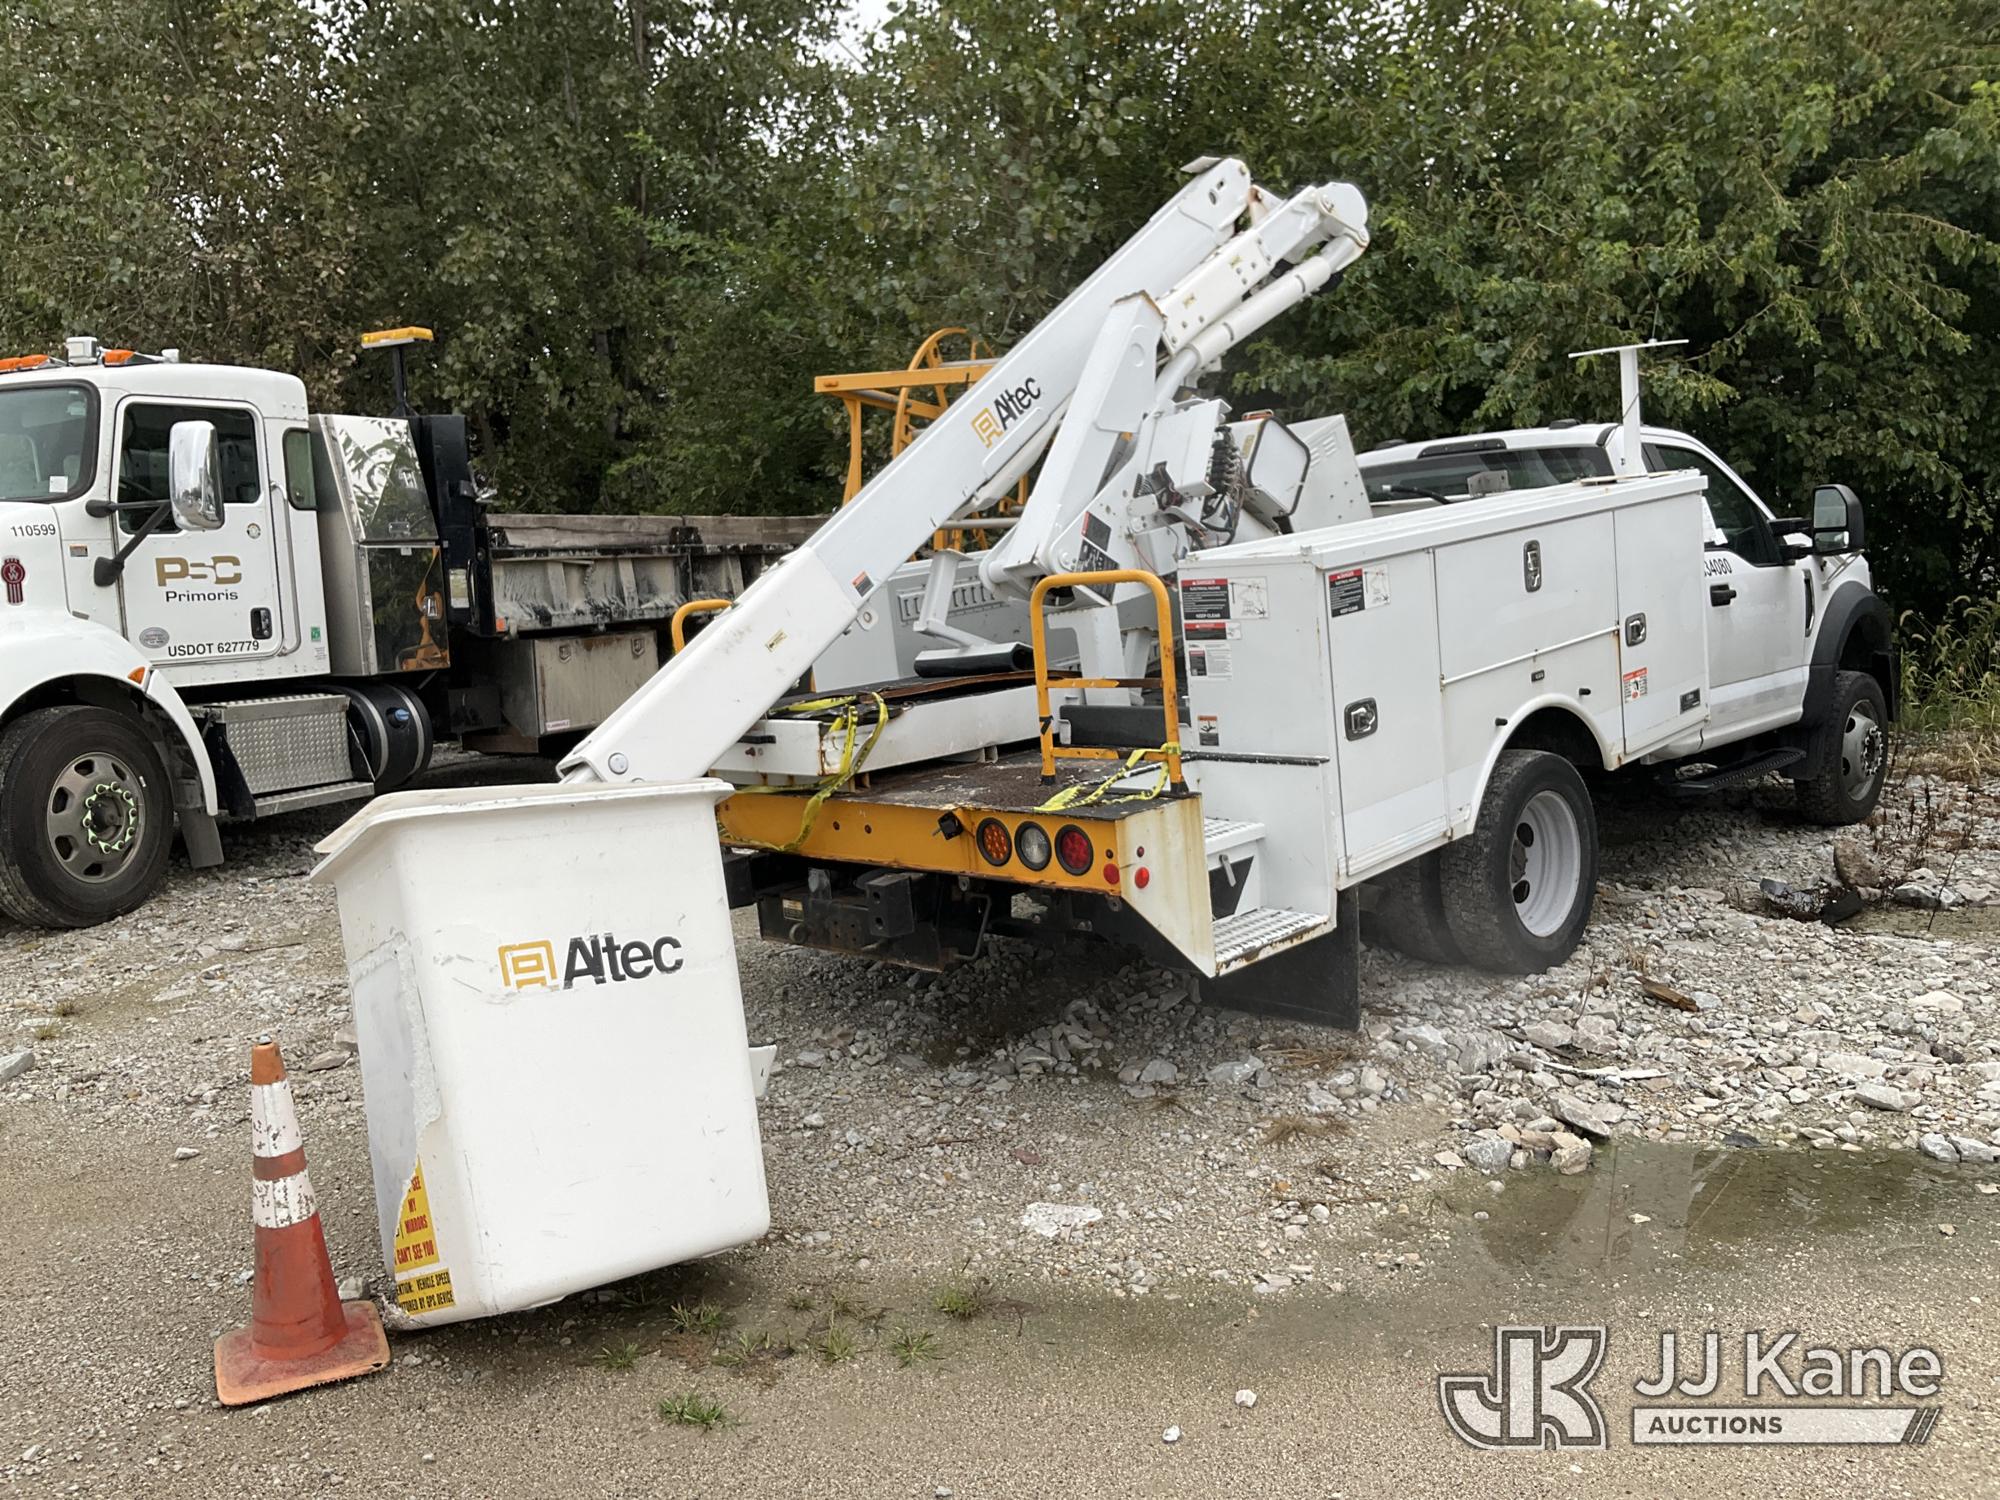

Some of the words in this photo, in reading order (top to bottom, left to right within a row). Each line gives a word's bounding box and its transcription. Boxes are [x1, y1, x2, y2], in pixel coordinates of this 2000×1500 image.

[994, 377, 1041, 431] Altec
[10, 523, 56, 537] 110599
[165, 588, 239, 602] Primoris
[168, 642, 214, 657] USDOT
[217, 640, 260, 654] 627779
[563, 932, 684, 990] Altec
[405, 1215, 428, 1233] MIRRORS
[416, 1276, 434, 1290] VEHICLE
[435, 1272, 450, 1286] SPEED
